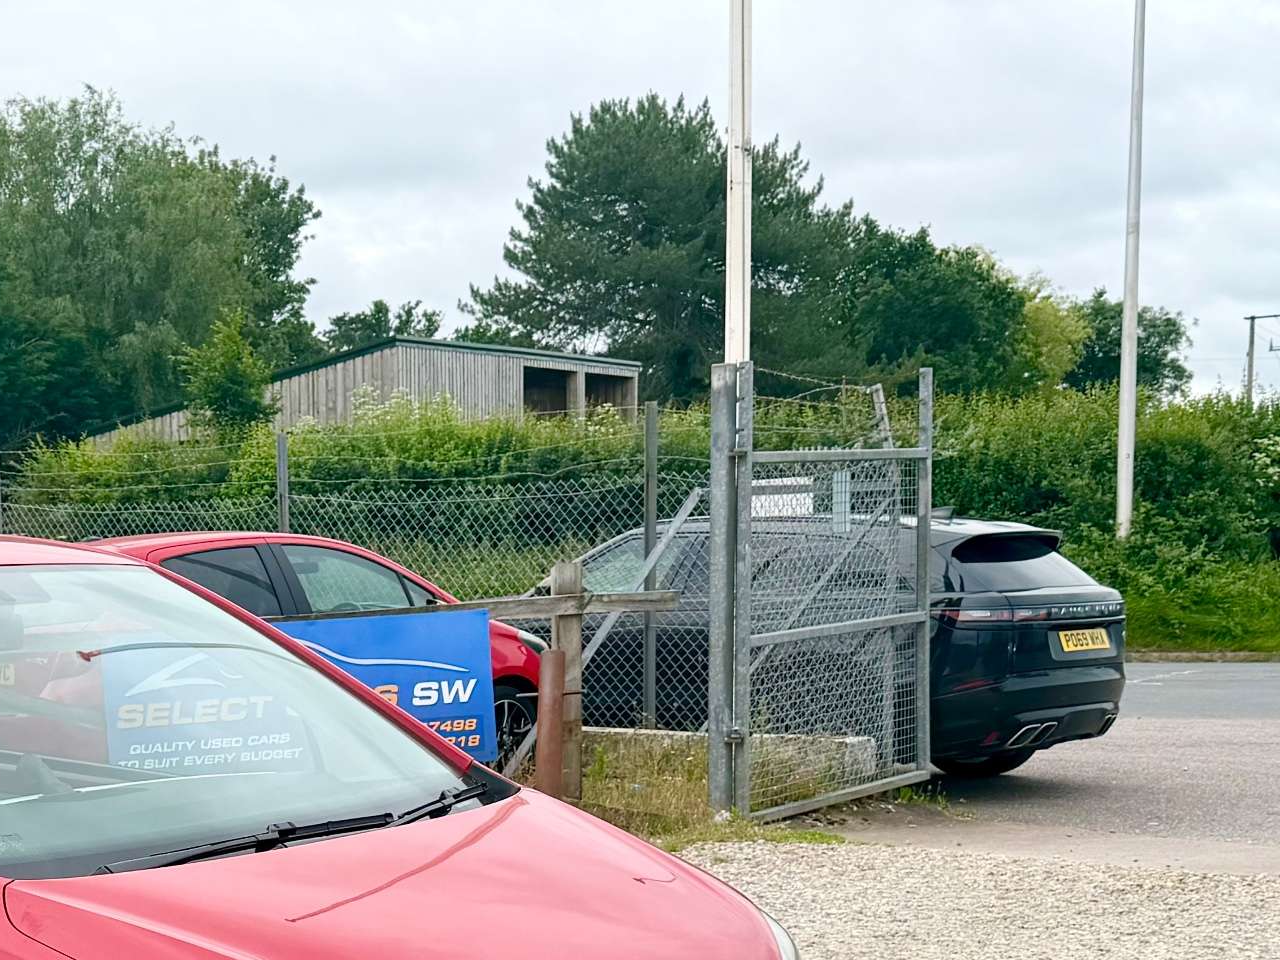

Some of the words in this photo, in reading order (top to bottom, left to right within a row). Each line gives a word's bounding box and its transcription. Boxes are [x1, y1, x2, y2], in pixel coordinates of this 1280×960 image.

[1064, 632, 1089, 648] PO69
[116, 696, 274, 729] SELECT
[412, 679, 478, 706] SW
[129, 740, 196, 755] QUALITY
[200, 736, 243, 750] USED
[247, 733, 291, 747] CARS
[144, 757, 180, 769] SUIT
[184, 752, 237, 766] EVERY
[240, 747, 304, 762] BUDGET
